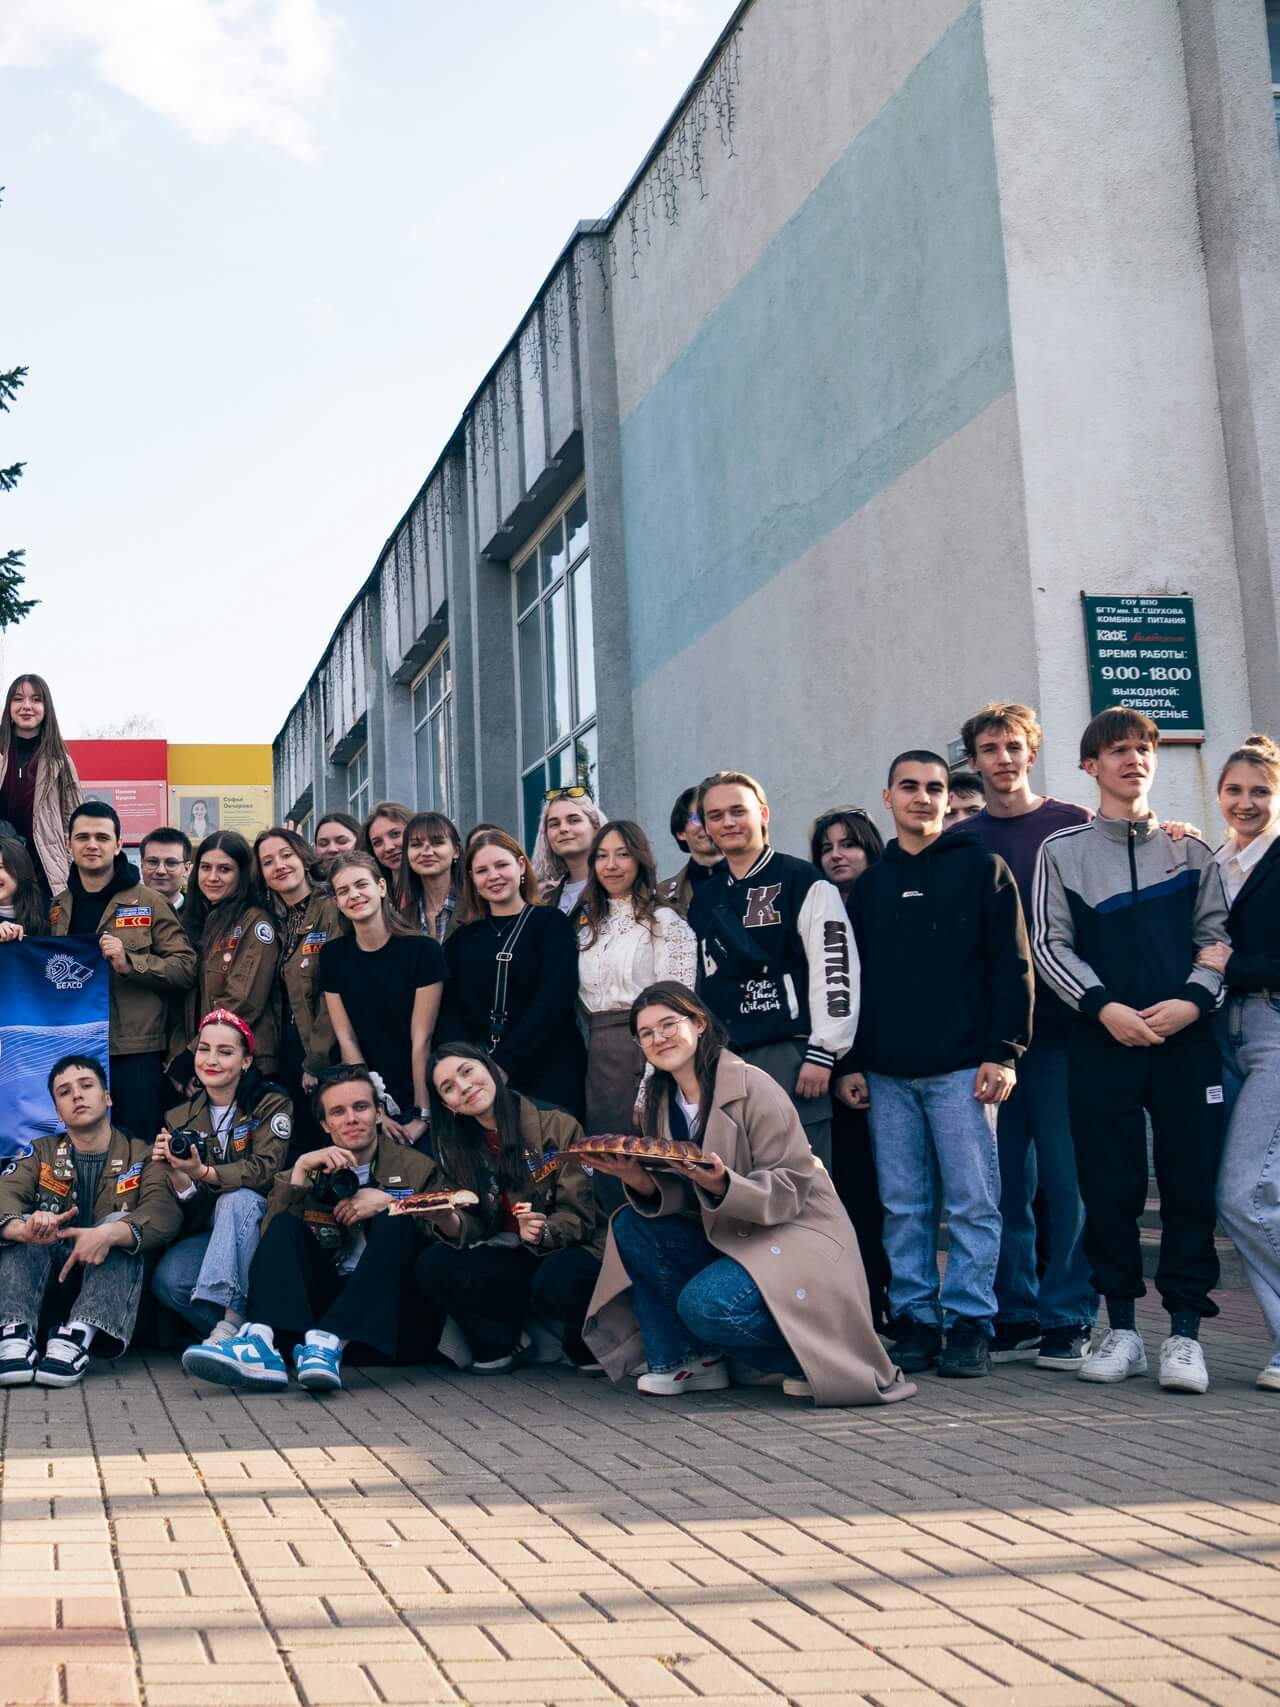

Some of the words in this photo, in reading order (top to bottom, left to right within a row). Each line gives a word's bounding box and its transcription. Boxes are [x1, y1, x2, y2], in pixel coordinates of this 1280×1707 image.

[1097, 615, 1143, 624] КОМБИНАТ
[1147, 617, 1186, 625] ПИТАНИЯ
[1099, 649, 1137, 659] ВРЕМЯ
[1140, 650, 1188, 660] РАБОТЫ:
[1120, 699, 1175, 709] СУББОТА,
[743, 883, 782, 928] K
